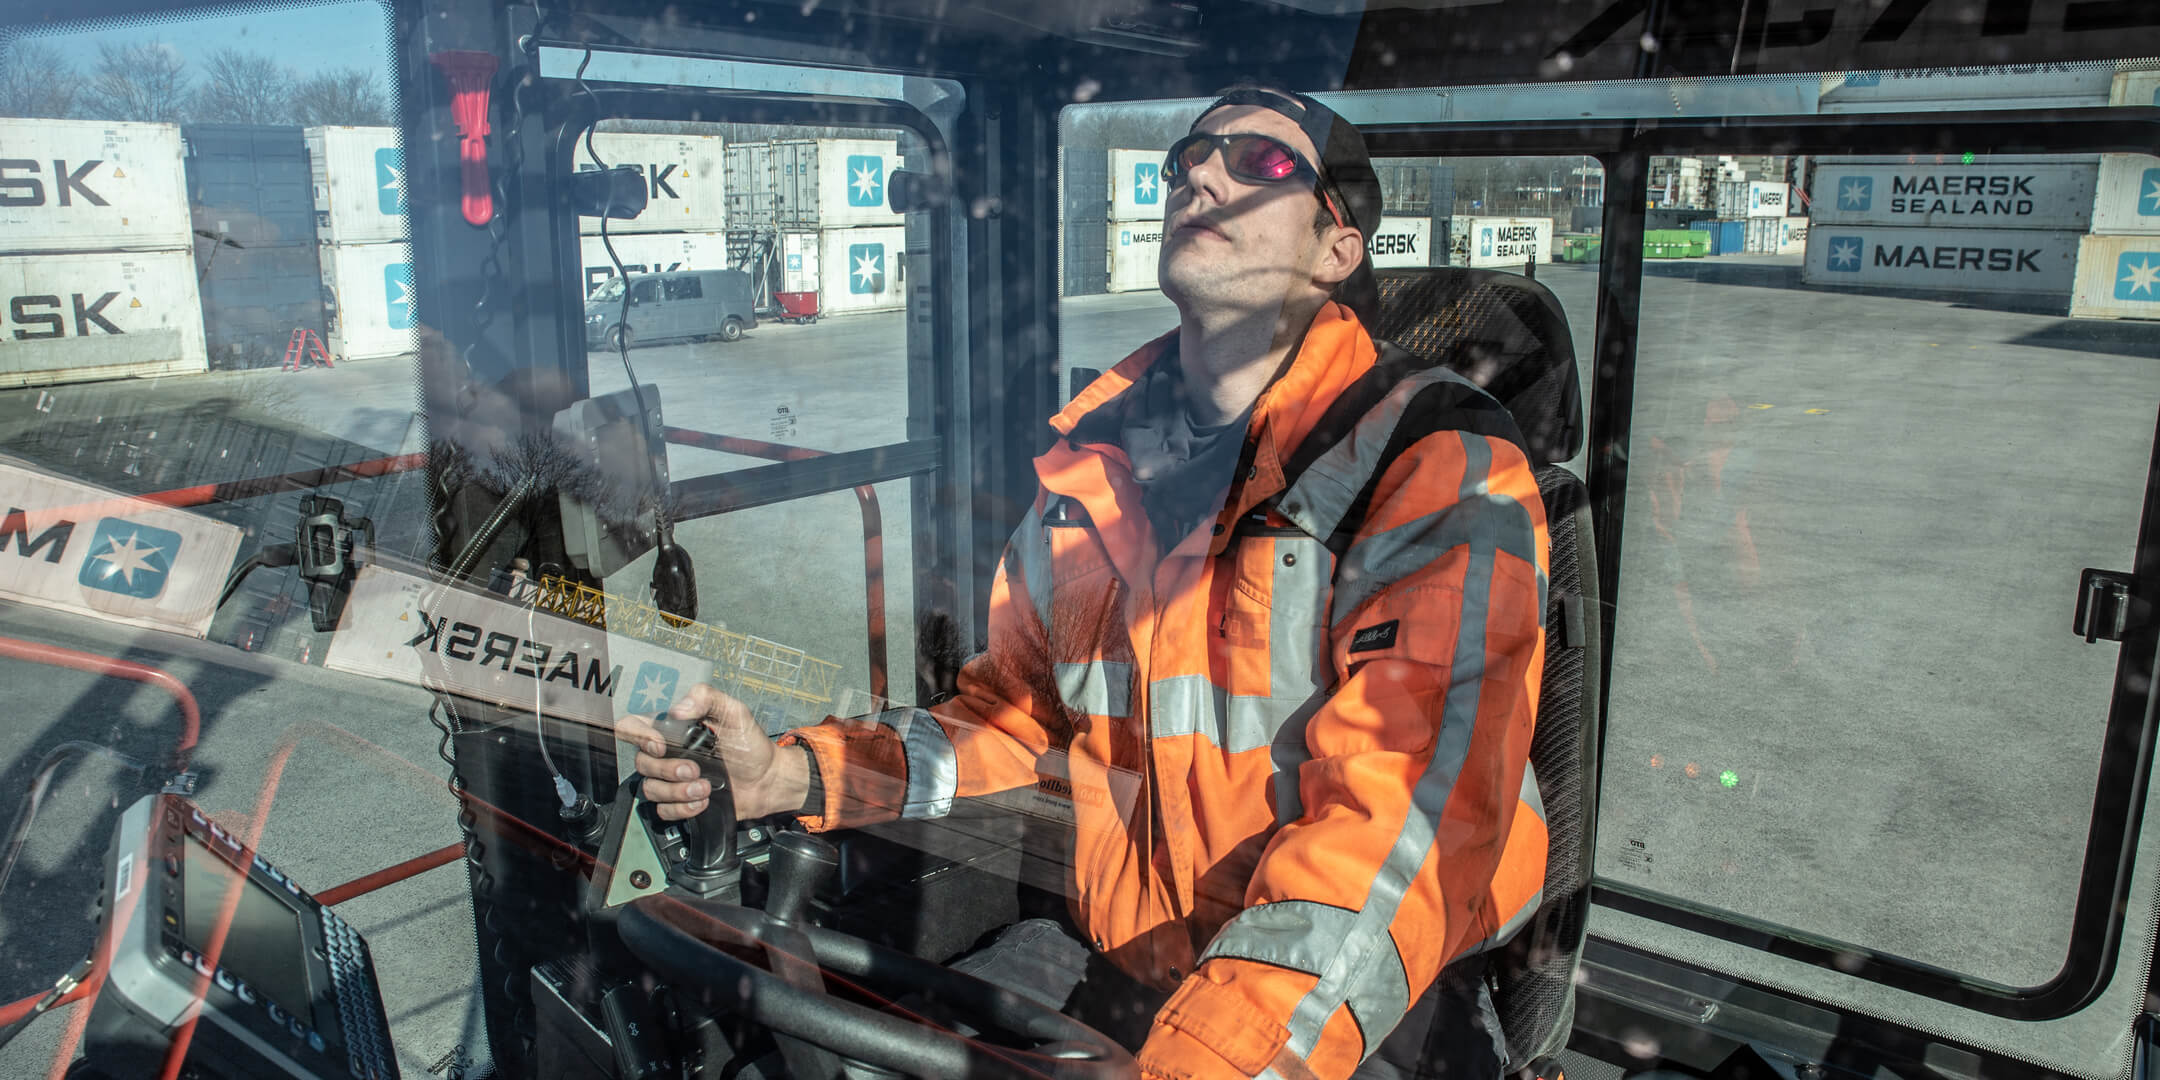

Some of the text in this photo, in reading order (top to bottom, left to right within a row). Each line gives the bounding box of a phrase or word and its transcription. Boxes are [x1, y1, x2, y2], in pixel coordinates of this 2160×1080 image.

[1892, 176, 2036, 196] MAERSK
[1891, 199, 2034, 215] SEALAND
[1497, 226, 1537, 242] MAERSK
[1497, 244, 1537, 257] SEALAND
[1874, 244, 2043, 273] MAERSK
